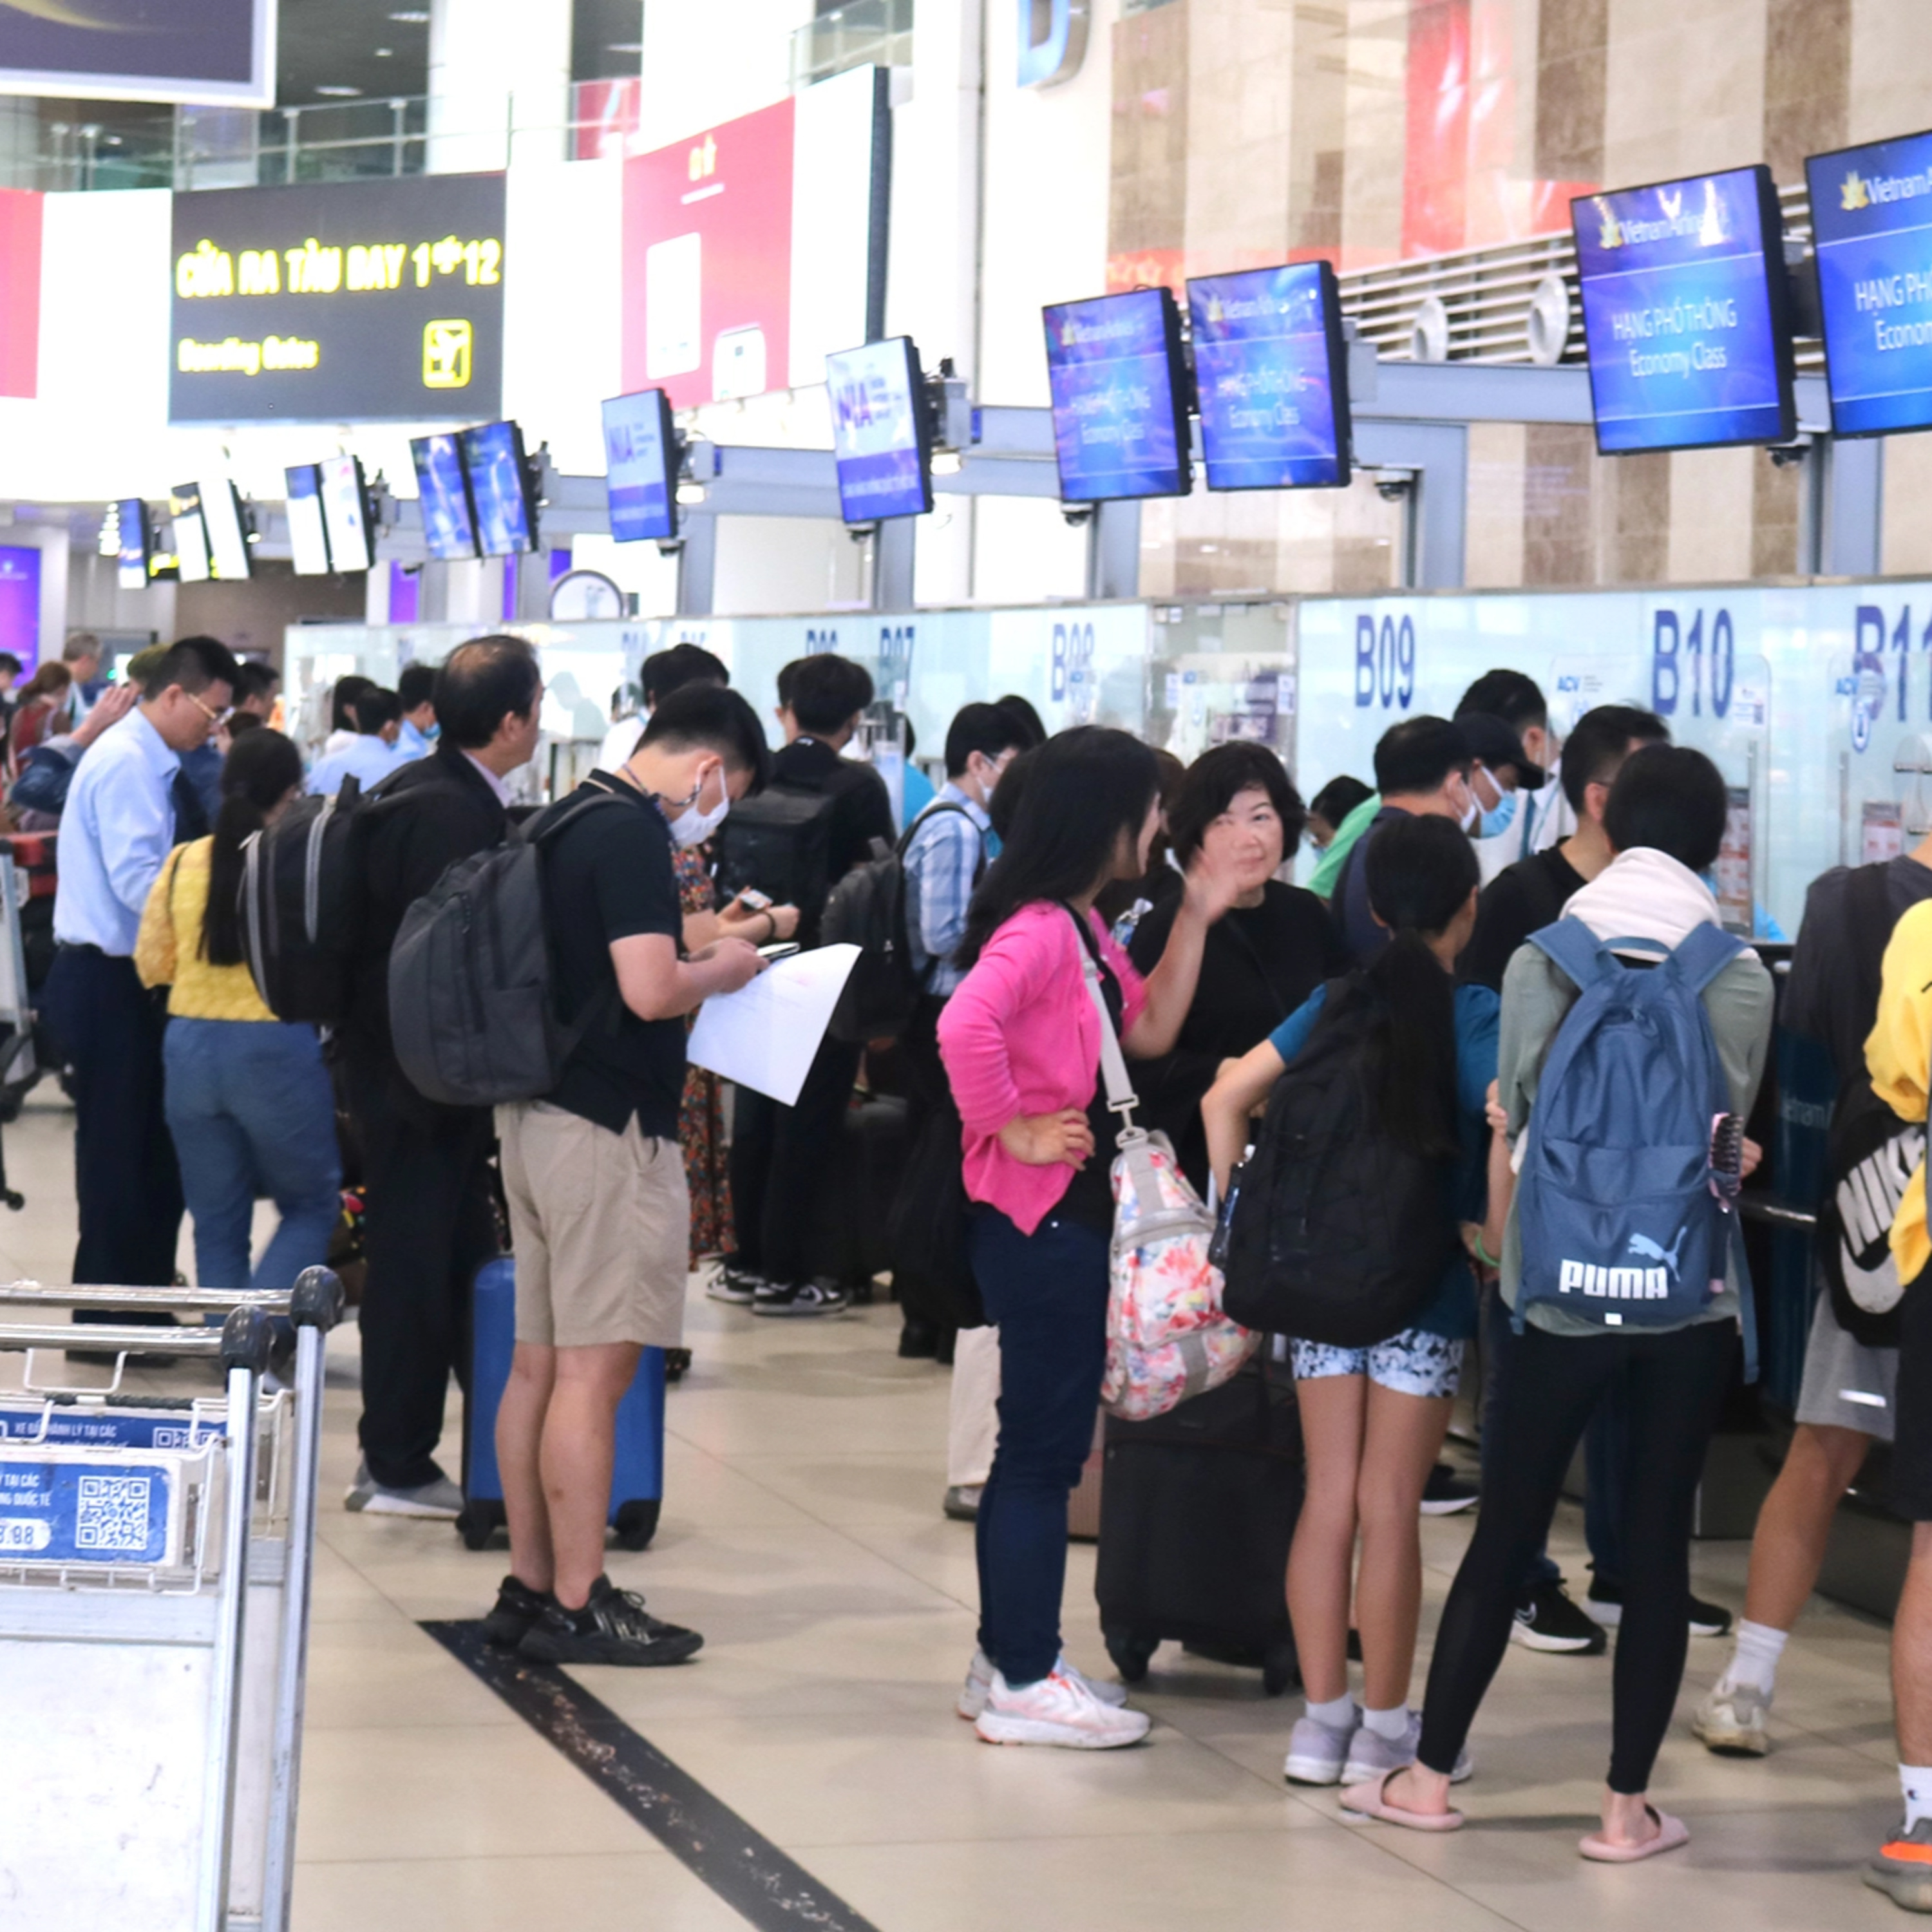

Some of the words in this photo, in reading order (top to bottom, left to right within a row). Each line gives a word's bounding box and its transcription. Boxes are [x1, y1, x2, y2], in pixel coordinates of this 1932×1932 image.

[1865, 175, 1927, 205] Vietnam
[1620, 219, 1670, 245] Vietnam
[1855, 275, 1904, 317] HẠNG
[1904, 270, 1932, 305] PH
[1612, 309, 1653, 346] HẠNG
[1629, 349, 1690, 379] Economy
[1692, 341, 1727, 371] Class
[1355, 614, 1416, 710] B09
[1652, 608, 1734, 719] B10
[1559, 1259, 1668, 1300] PUMA
[99, 1424, 117, 1437] CÁC
[21, 1472, 40, 1488] CÁC
